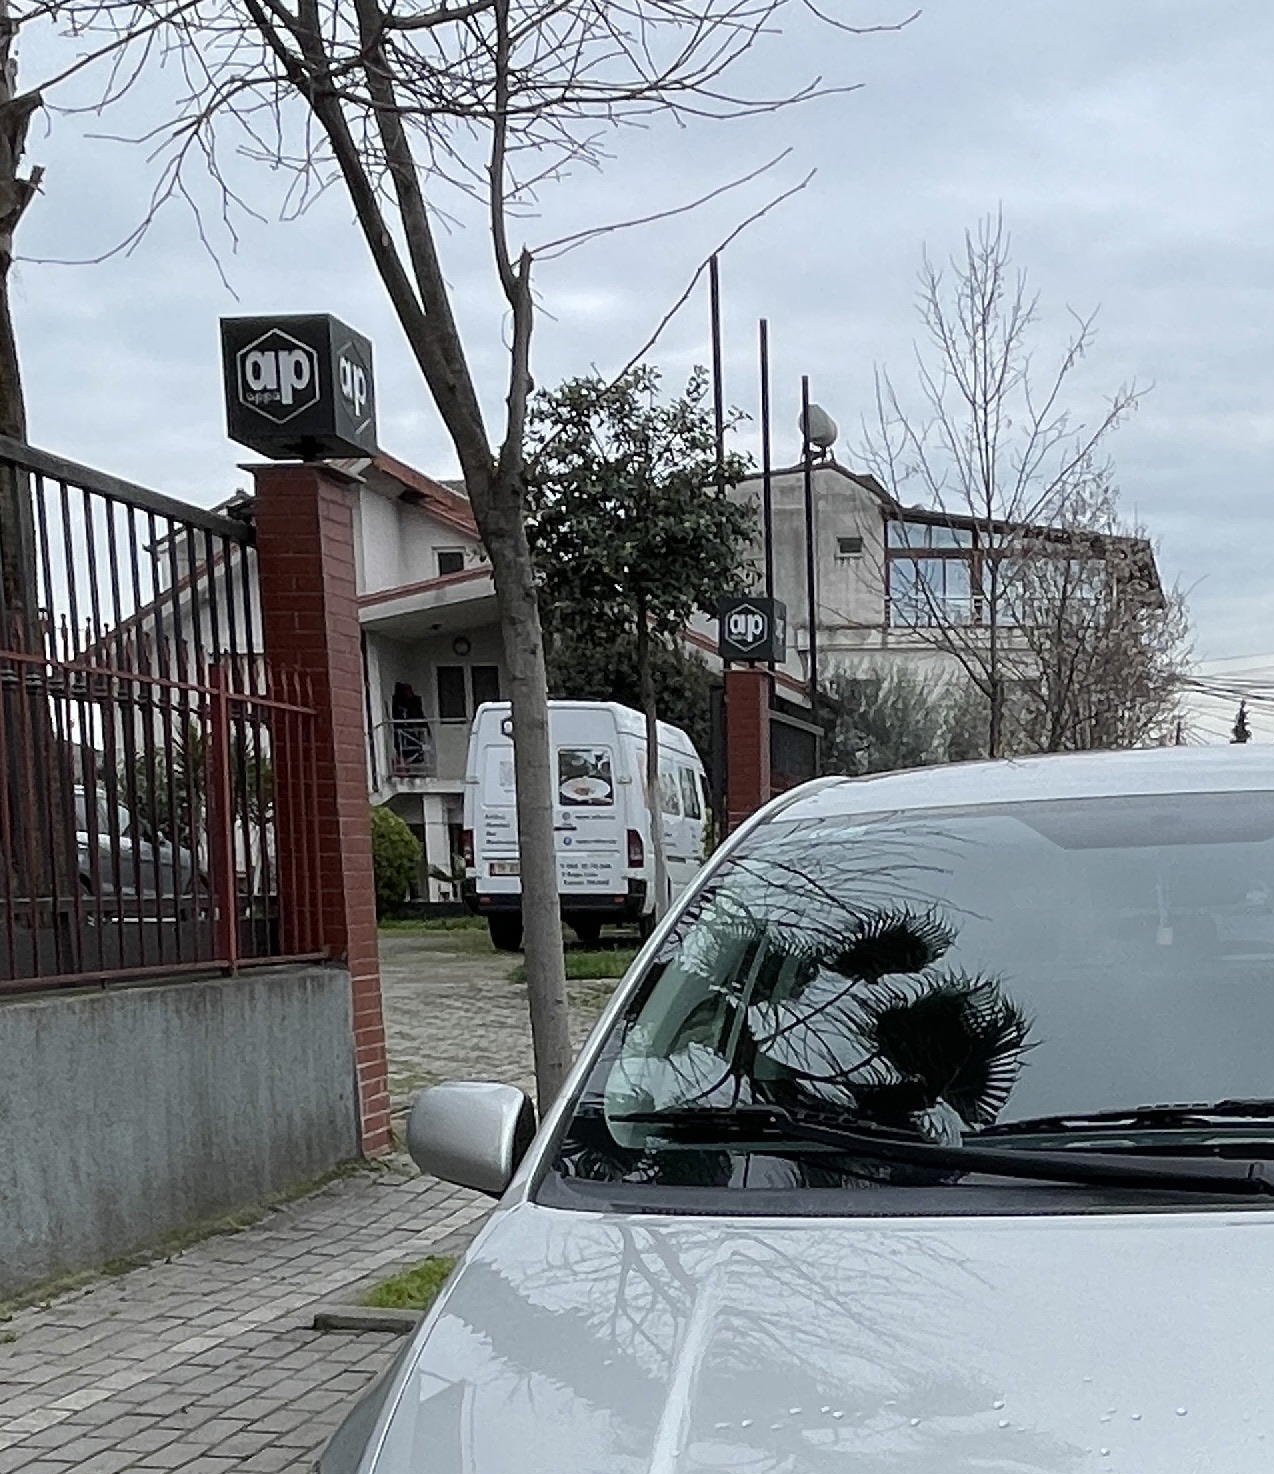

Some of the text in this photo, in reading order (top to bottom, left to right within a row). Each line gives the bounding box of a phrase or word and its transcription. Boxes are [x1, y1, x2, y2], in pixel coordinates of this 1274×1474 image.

[245, 349, 311, 405] ap
[339, 356, 367, 417] ap
[730, 613, 763, 643] ap
